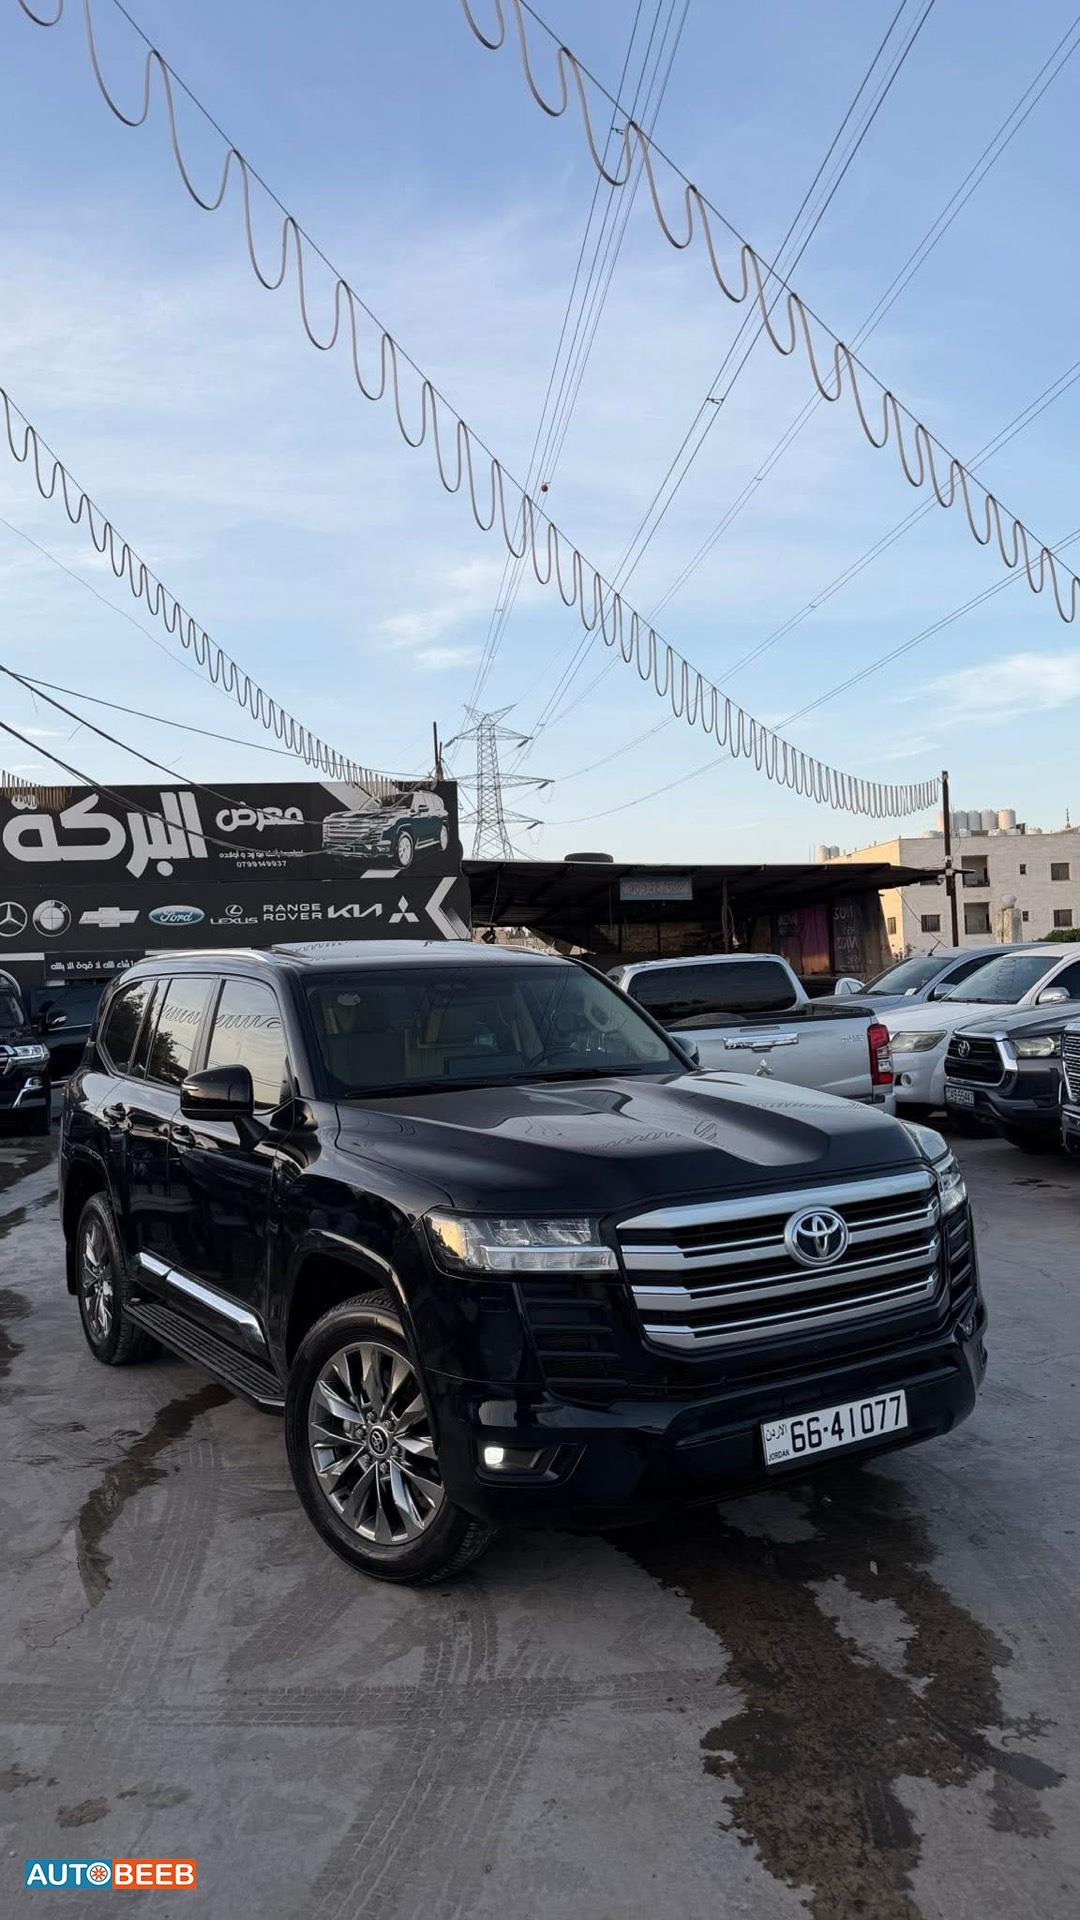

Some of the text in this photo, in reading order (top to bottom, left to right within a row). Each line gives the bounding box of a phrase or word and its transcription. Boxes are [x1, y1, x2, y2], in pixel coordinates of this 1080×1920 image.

[2, 791, 304, 879] معرض البركة
[263, 903, 321, 912] RANGE
[327, 903, 383, 918] KIA
[159, 911, 193, 923] Ford
[210, 917, 258, 925] LEXUS
[263, 911, 323, 921] ROVER
[790, 1395, 902, 1453] 66-41077
[768, 1449, 790, 1462] JORDAN
